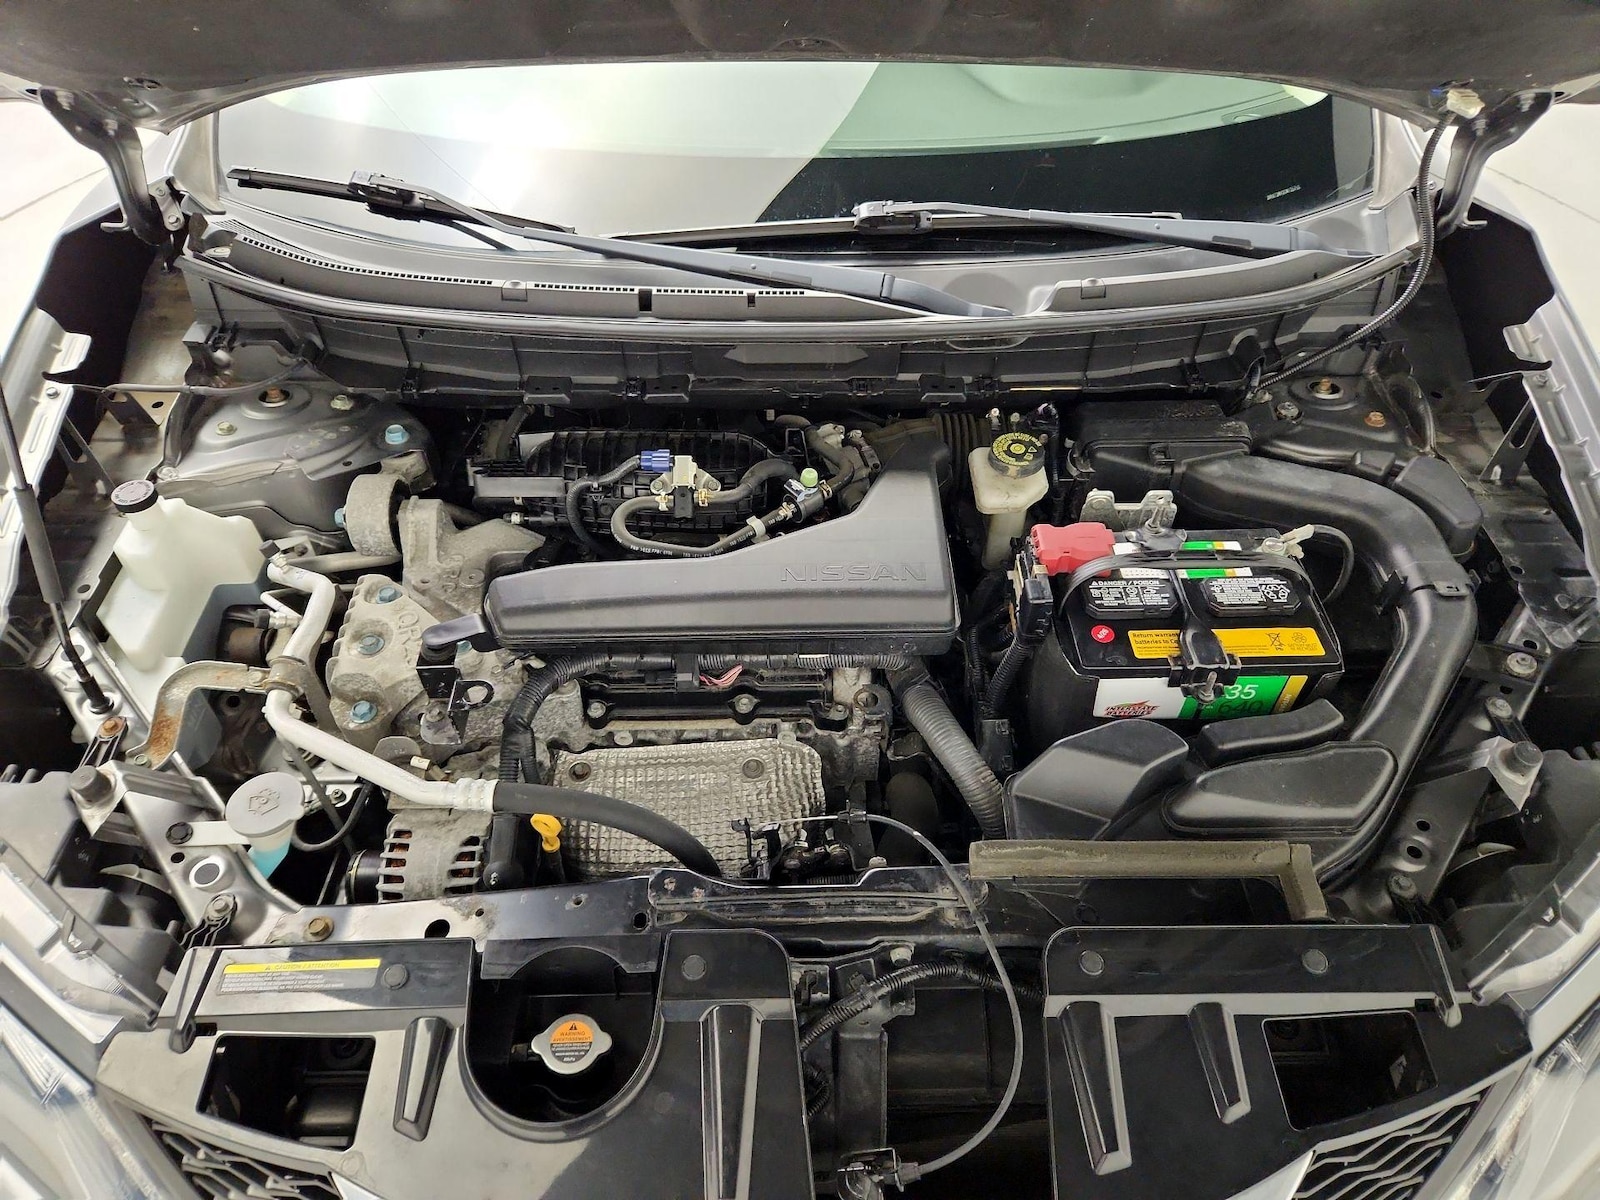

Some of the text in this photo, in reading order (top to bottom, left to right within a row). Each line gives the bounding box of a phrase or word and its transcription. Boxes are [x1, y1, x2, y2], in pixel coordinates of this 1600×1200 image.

[780, 563, 927, 582] NISSAN
[1225, 684, 1260, 700] 35
[1218, 700, 1264, 716] 640
